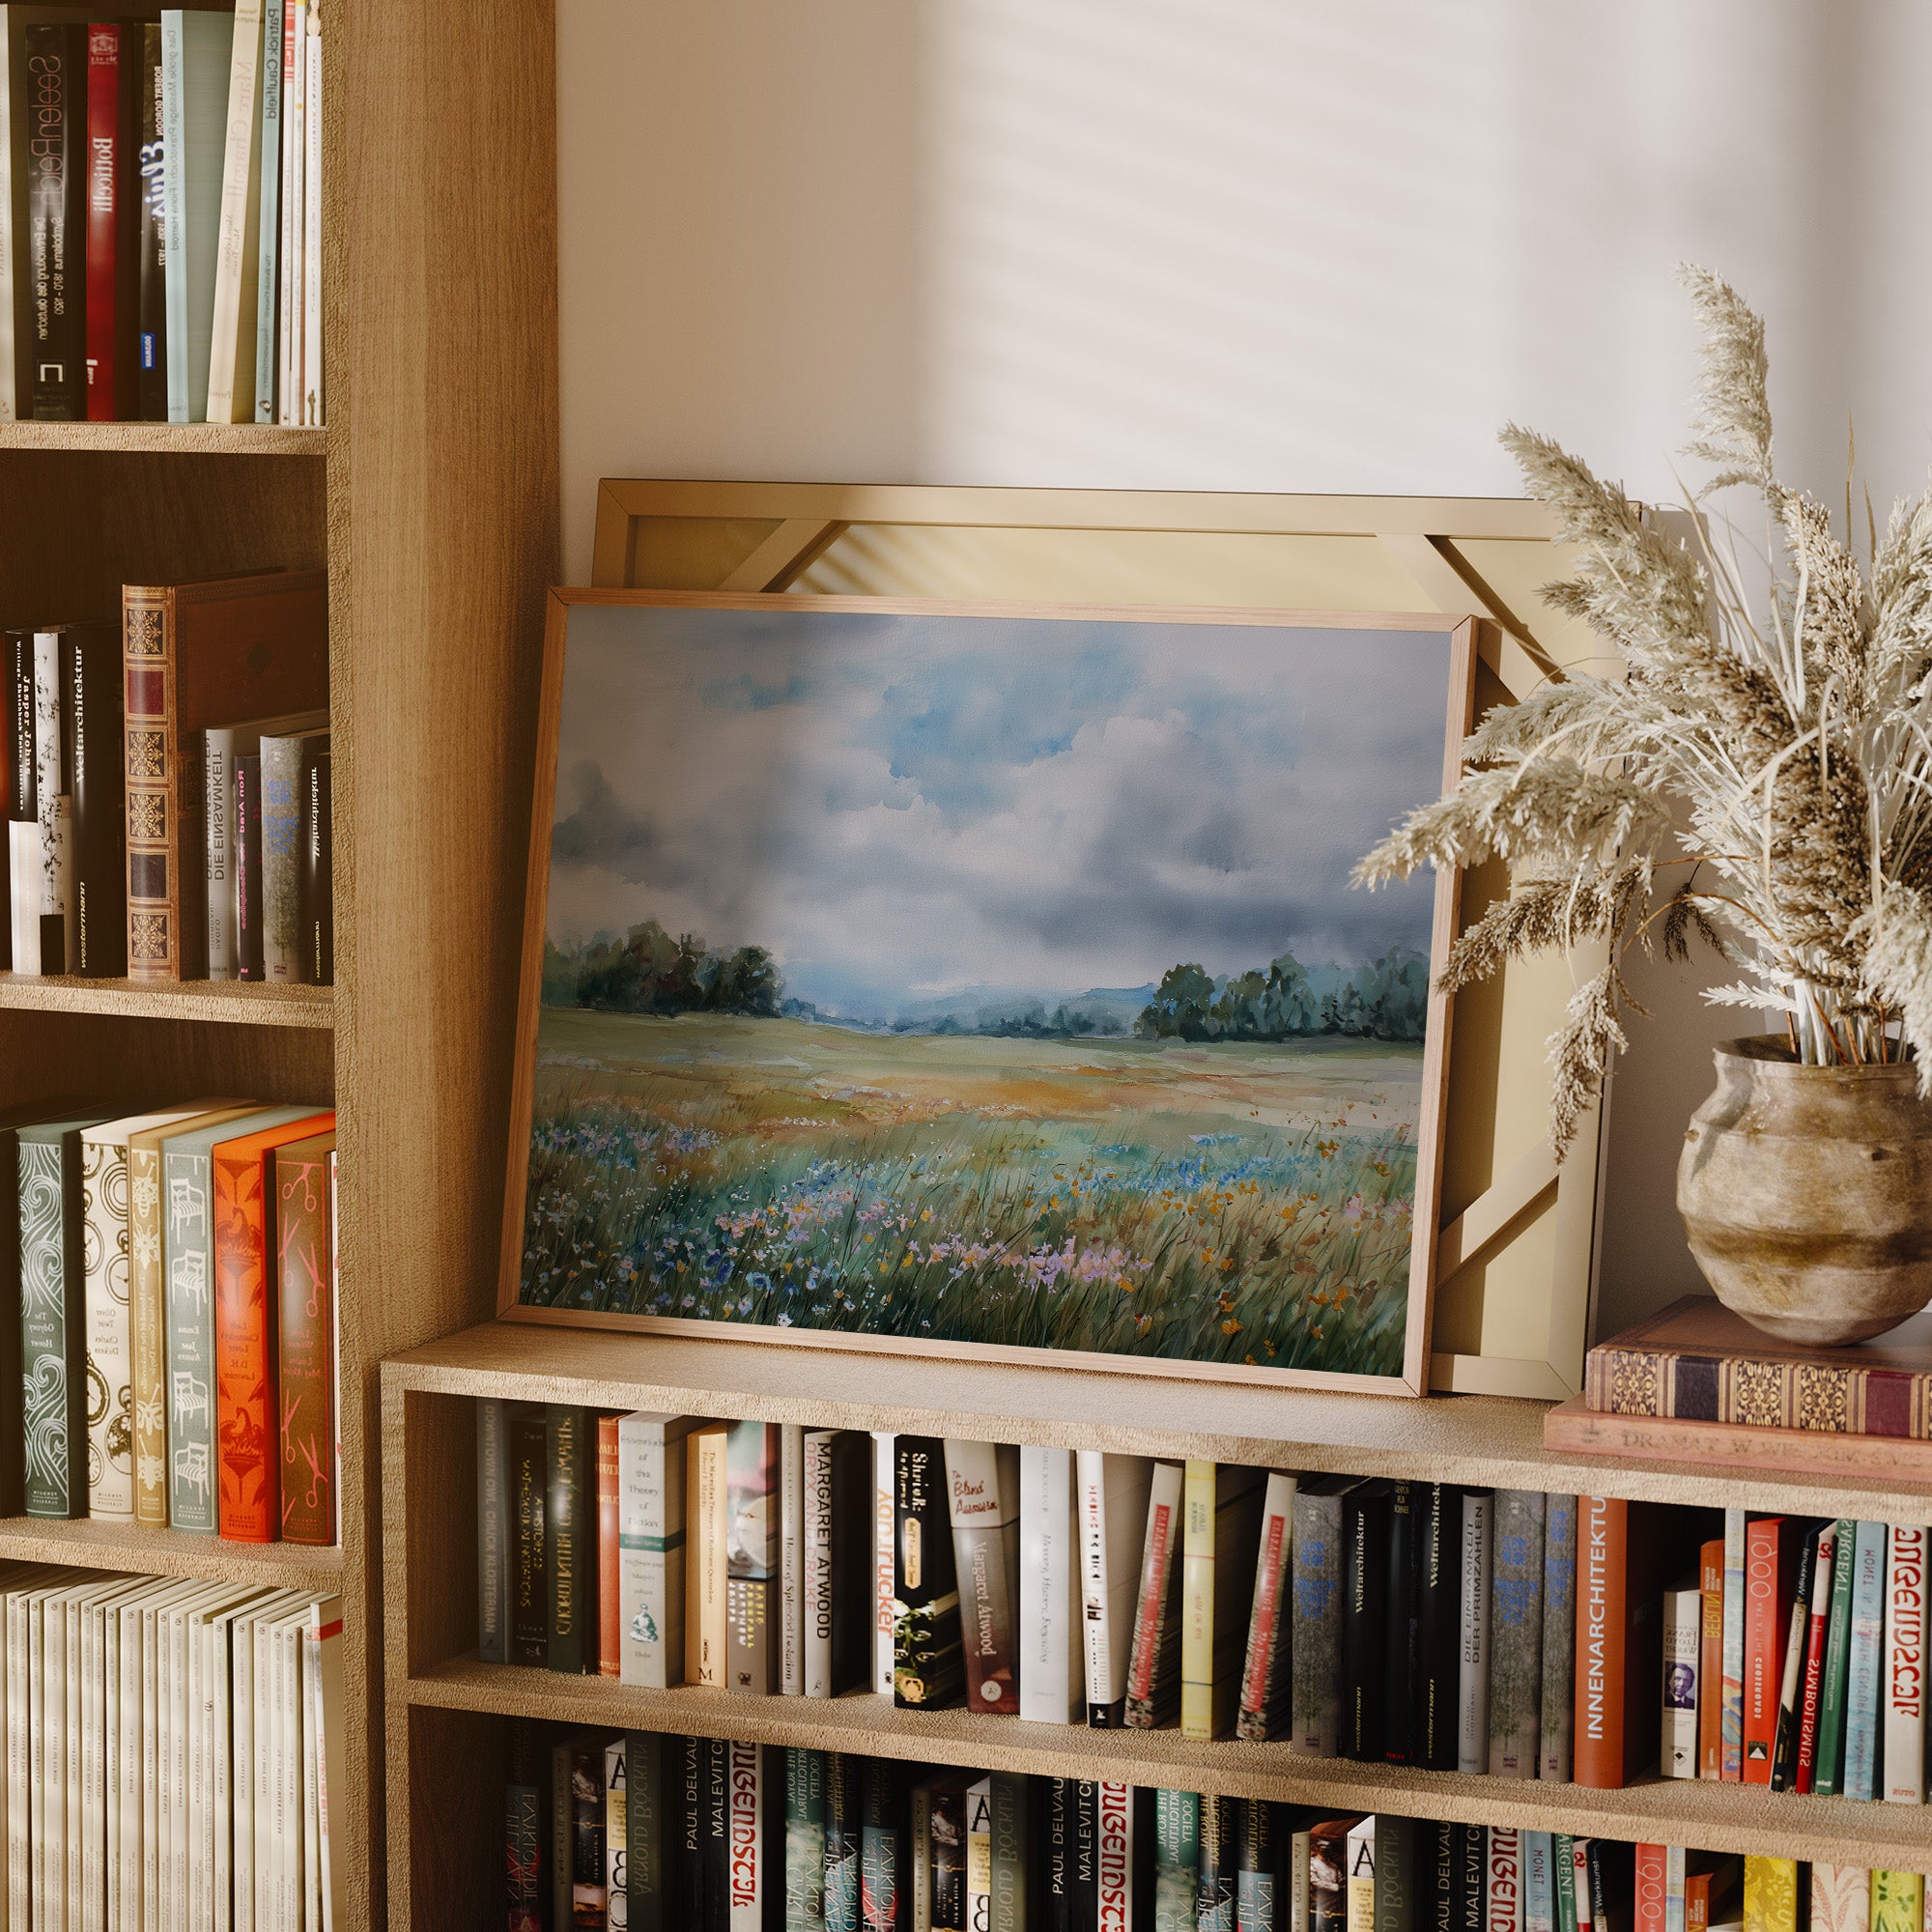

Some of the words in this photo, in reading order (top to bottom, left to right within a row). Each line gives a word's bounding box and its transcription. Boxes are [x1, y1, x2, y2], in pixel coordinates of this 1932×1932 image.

[22, 675, 32, 726] Jasper
[74, 645, 85, 783] Weltarchitektur
[23, 731, 32, 776] Johns
[806, 1441, 817, 1492] ORYX
[806, 1497, 816, 1538] AND
[817, 1442, 831, 1551] MARGARET
[806, 1546, 817, 1612] CRAKE
[972, 1541, 989, 1601] Margaret
[1355, 1510, 1365, 1613] Weltarchitektur
[1464, 1520, 1473, 1629] EINSAMKEIT
[1473, 1506, 1482, 1622] PRIMZAHLEN
[817, 1557, 831, 1639] ATWOOD
[1587, 1496, 1606, 1741] INNENARCHITEKTU
[978, 1604, 997, 1656] Atwood
[1472, 1628, 1481, 1663] DER
[687, 1807, 697, 1850] PAUL
[1052, 1851, 1064, 1894] PAUL
[1352, 1838, 1375, 1877] A
[1533, 1849, 1545, 1886] MONET
[1594, 1861, 1604, 1908] Werkkunst
[1641, 1857, 1662, 1919] 1900
